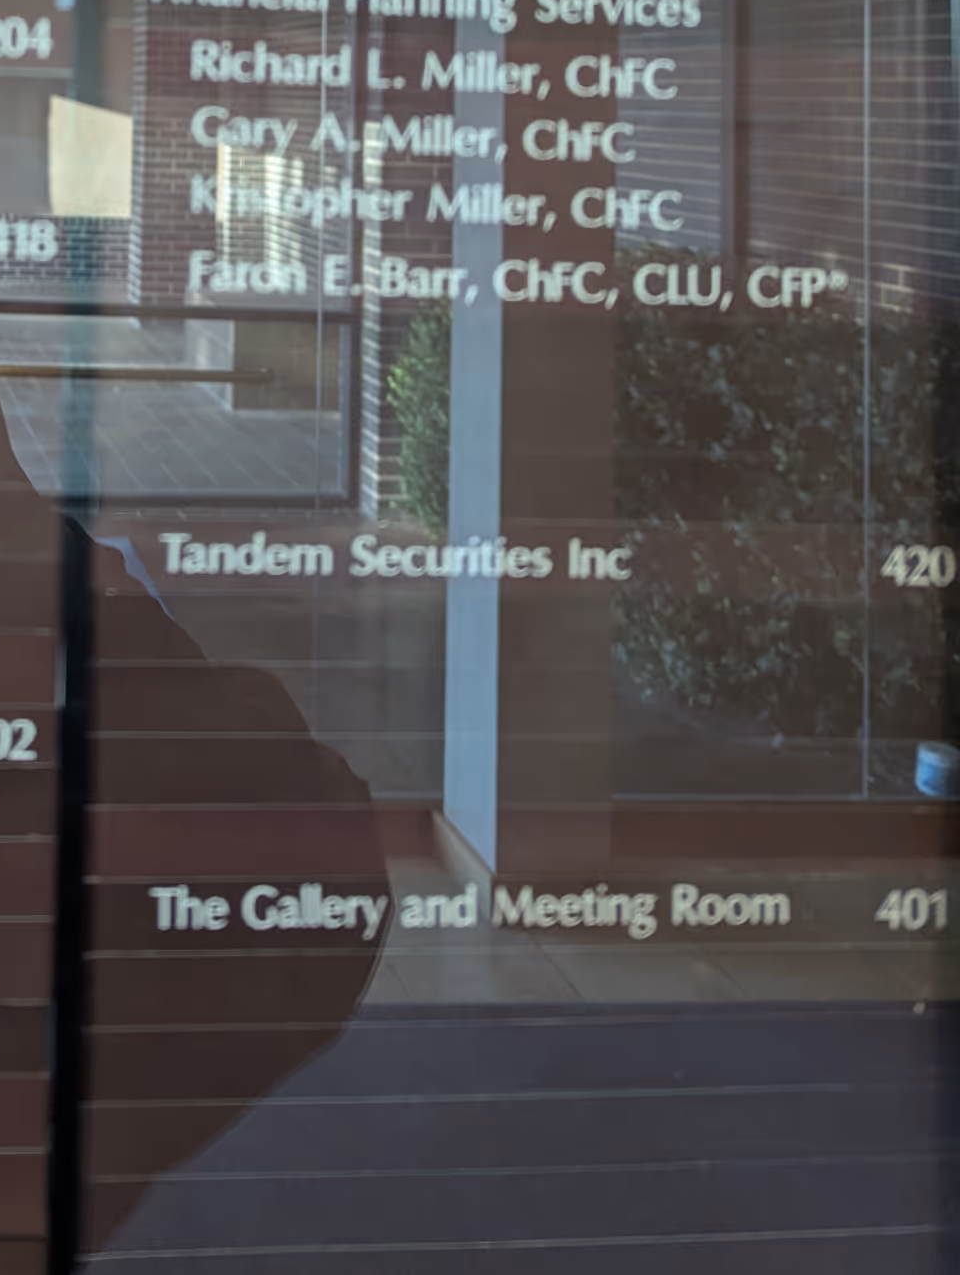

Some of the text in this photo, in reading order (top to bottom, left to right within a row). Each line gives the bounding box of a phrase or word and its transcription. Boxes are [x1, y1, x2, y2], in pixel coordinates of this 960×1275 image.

[190, 40, 678, 101] Richard L. Miller, ChFC
[190, 105, 636, 165] Gary A. Miller, ChFC
[426, 181, 555, 233] Miller,
[572, 187, 683, 233] ChFC
[323, 254, 362, 297] E.
[381, 256, 478, 306] Barr,
[492, 258, 618, 309] ChFC,
[633, 263, 733, 311] CLU,
[159, 531, 957, 589] Tandem Securities Inc 420
[148, 882, 947, 941] The Gallery and Meeting Room 401
